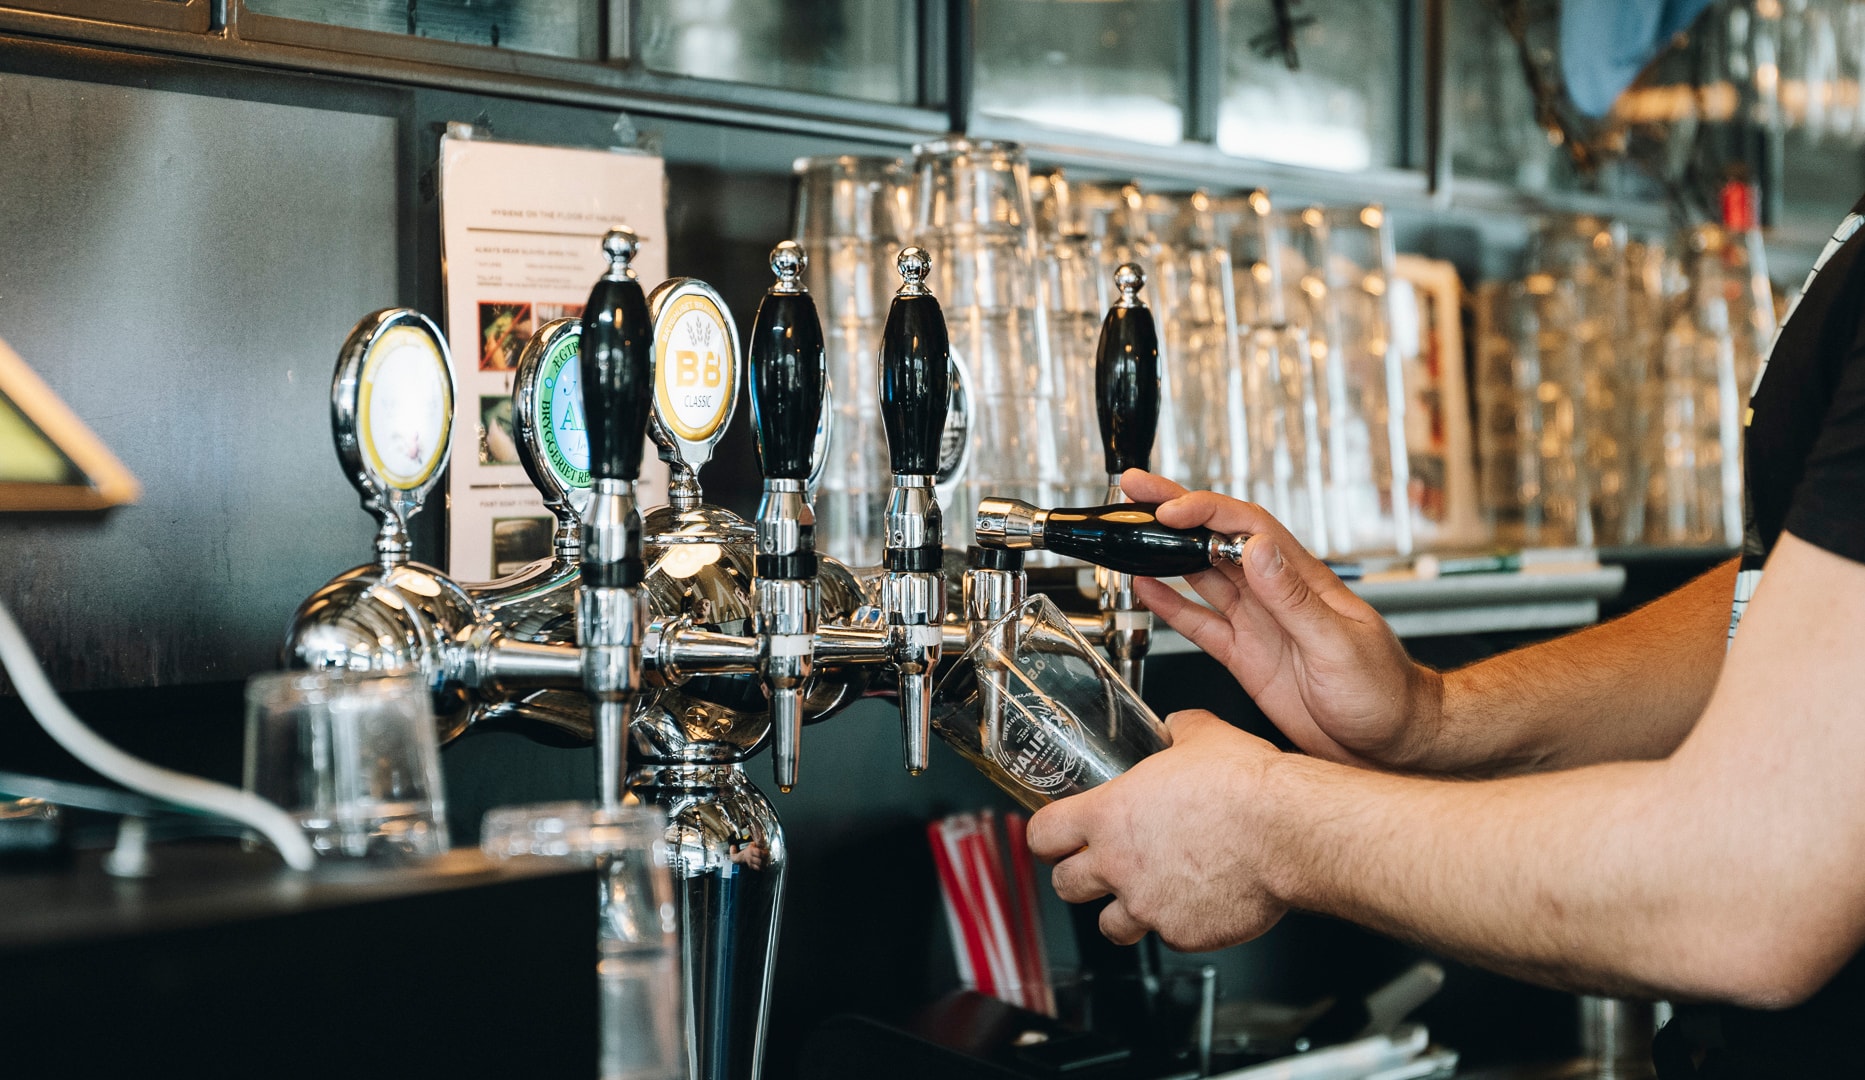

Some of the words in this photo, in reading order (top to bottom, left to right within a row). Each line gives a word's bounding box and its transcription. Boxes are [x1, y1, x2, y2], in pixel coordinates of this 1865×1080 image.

[491, 209, 524, 218] HYGIENE
[540, 211, 555, 219] THE
[557, 212, 583, 220] FLOOR
[684, 394, 712, 408] CLASSIC
[541, 400, 577, 481] BRYGGERIET
[577, 471, 591, 483] RE
[1009, 708, 1069, 778] HALIFAX
[1035, 743, 1055, 764] PILSNER
